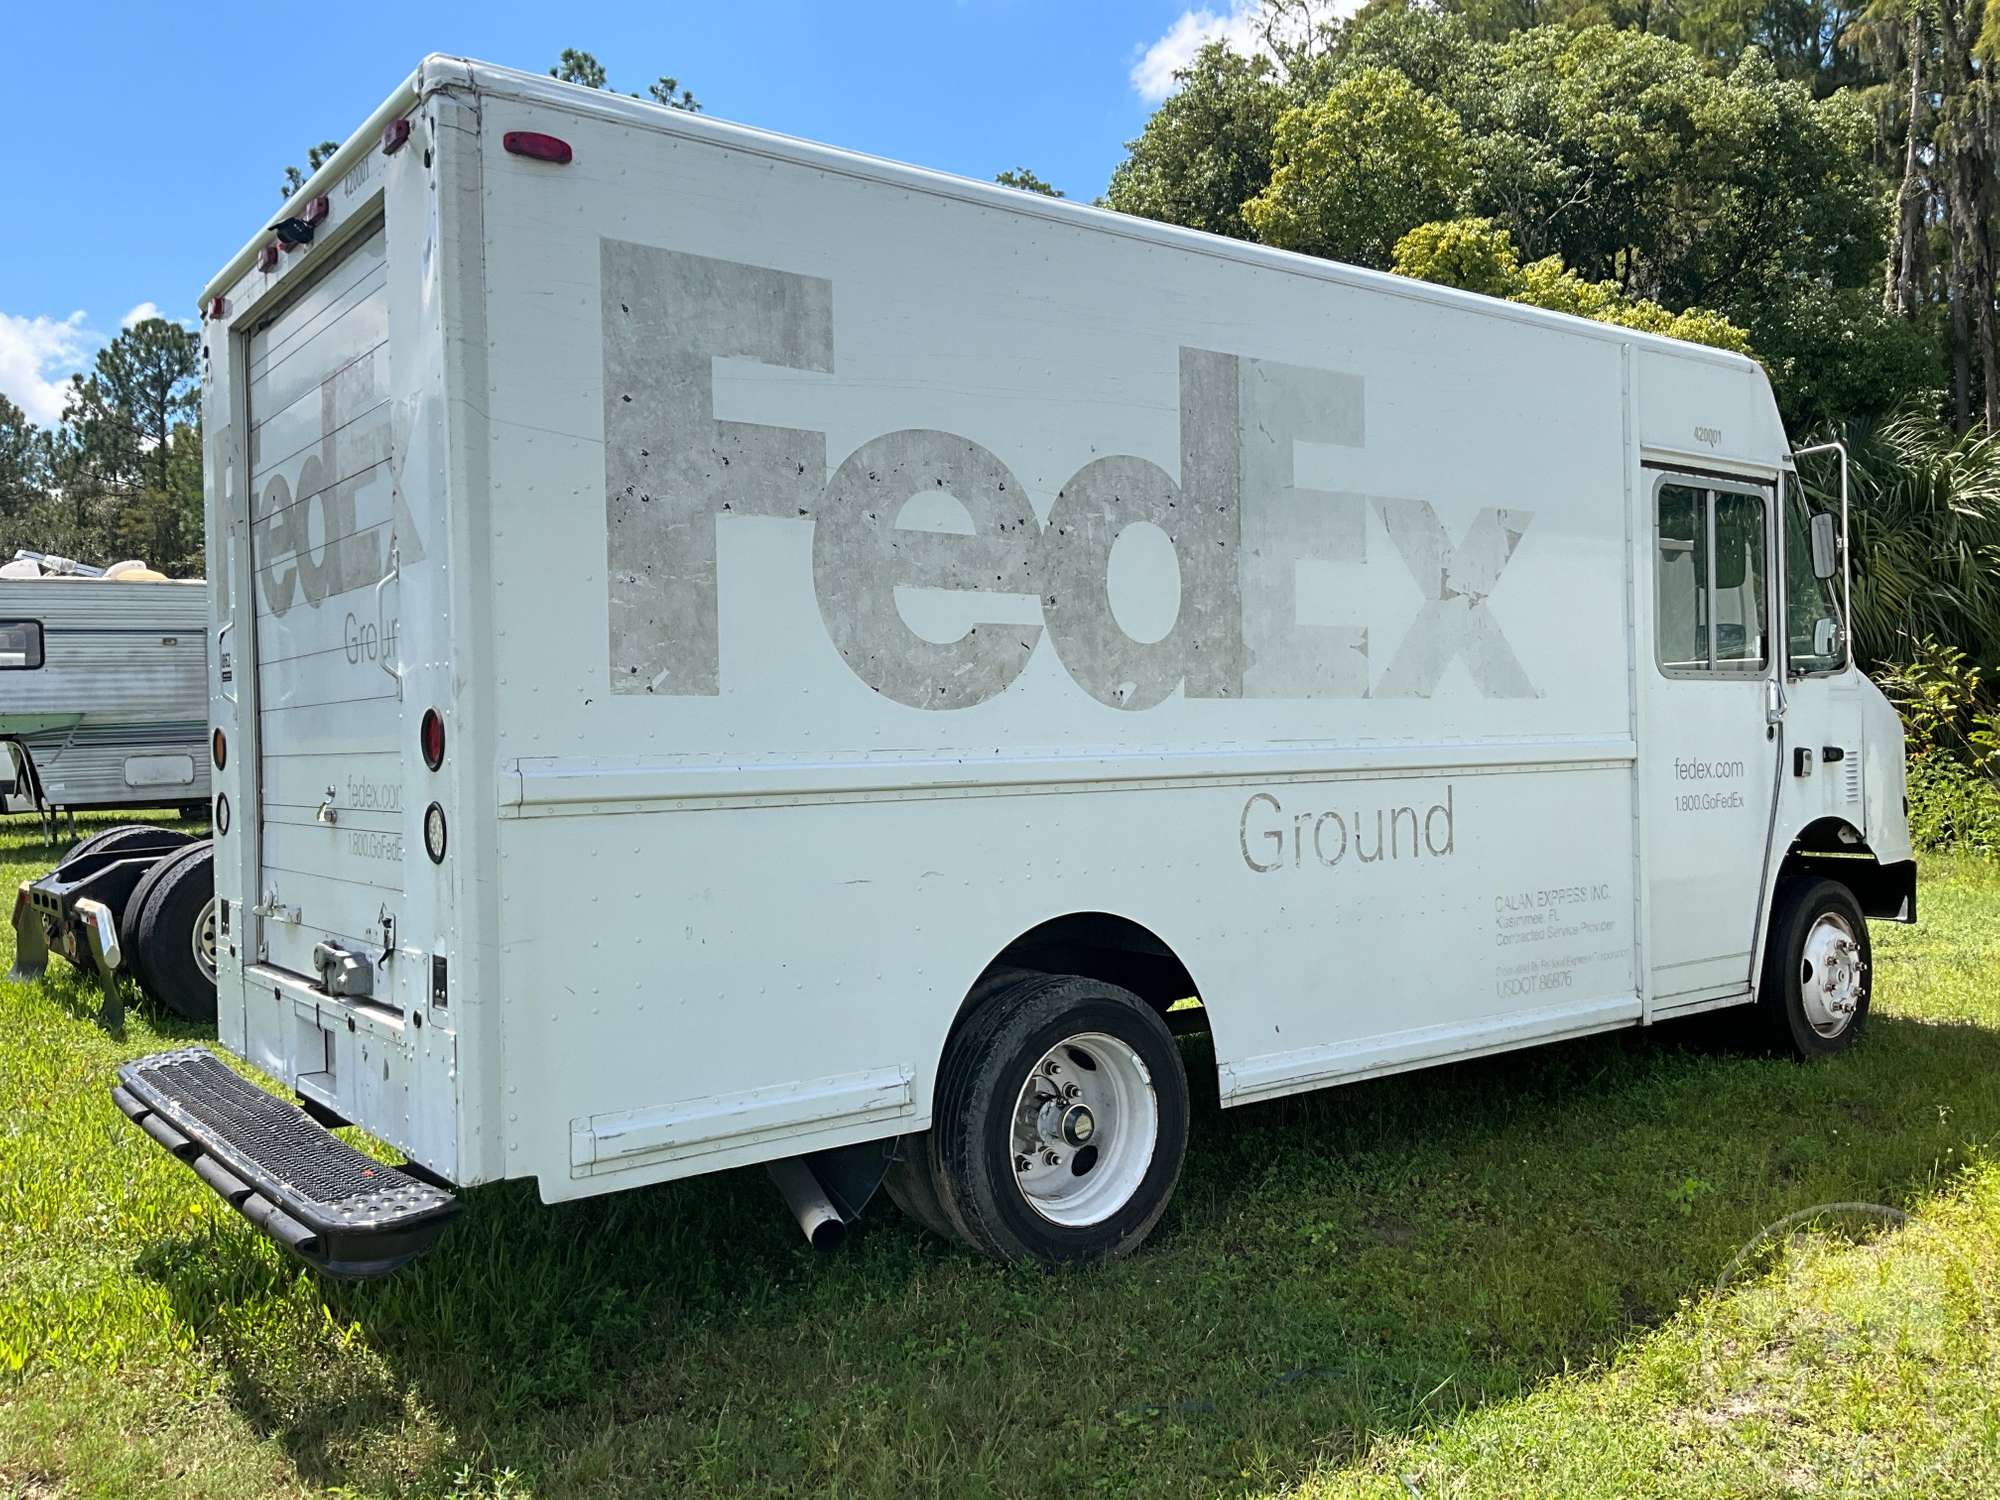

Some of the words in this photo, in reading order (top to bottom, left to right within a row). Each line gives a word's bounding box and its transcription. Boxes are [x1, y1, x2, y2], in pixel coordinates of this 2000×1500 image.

[600, 237, 1546, 712] FedEx
[212, 352, 428, 622] FedEx
[1674, 757, 1744, 780] fedex.com
[1675, 792, 1744, 811] 1.800.GoFedEx
[1240, 784, 1453, 873] Ground
[1537, 886, 1588, 908] EXPRESS
[1496, 975, 1537, 999] USDOT
